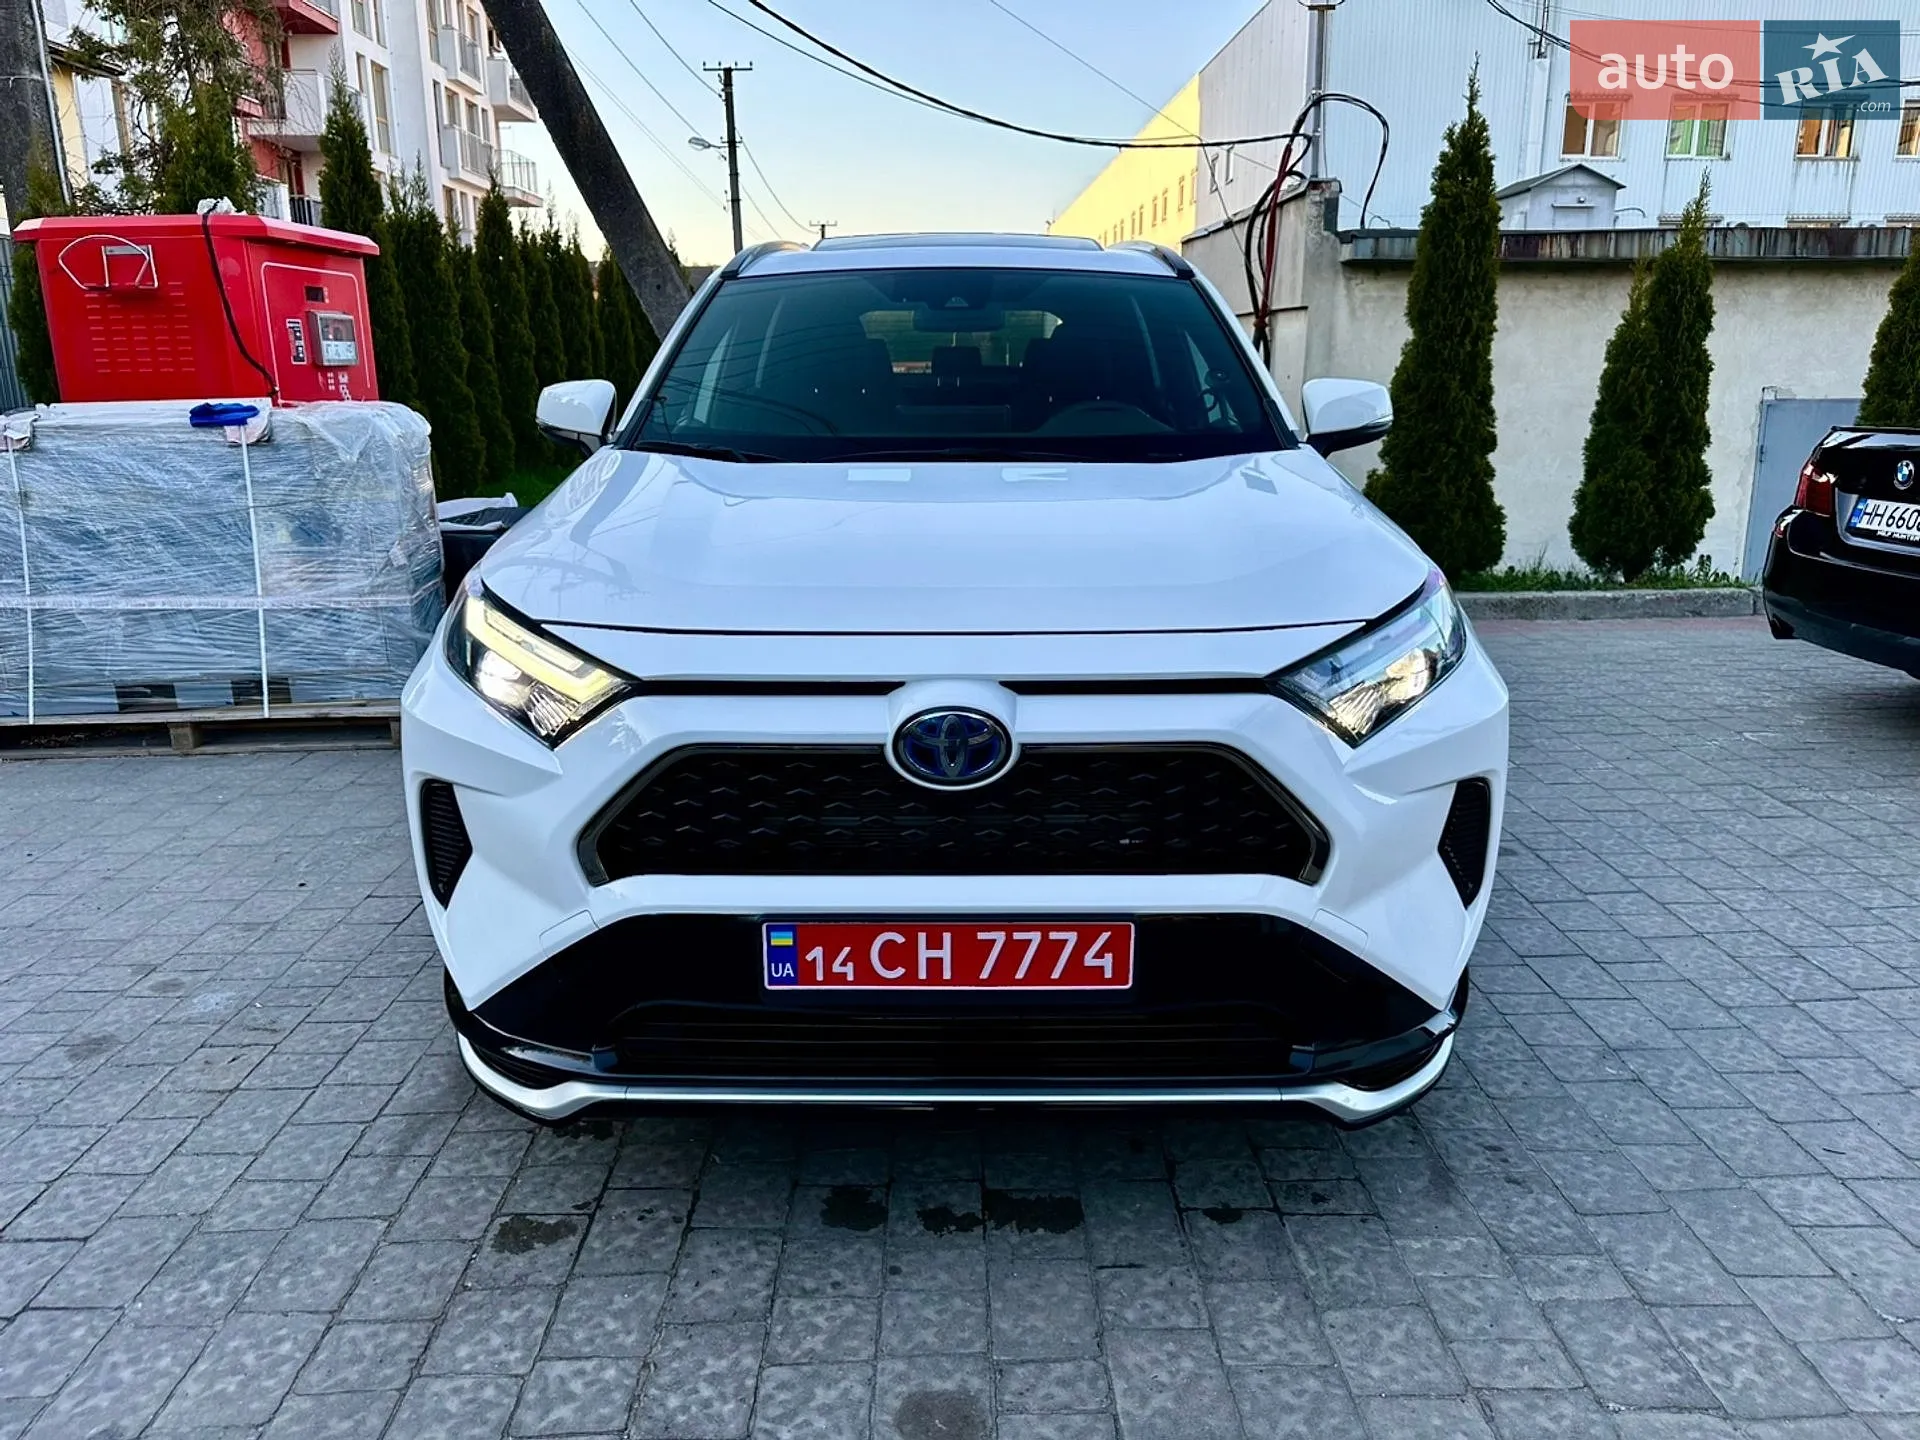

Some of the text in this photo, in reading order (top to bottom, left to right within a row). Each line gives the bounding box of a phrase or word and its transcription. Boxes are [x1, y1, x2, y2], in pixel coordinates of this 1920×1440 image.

[771, 962, 795, 978] UA
[805, 931, 1113, 982] 14 CH 7774
